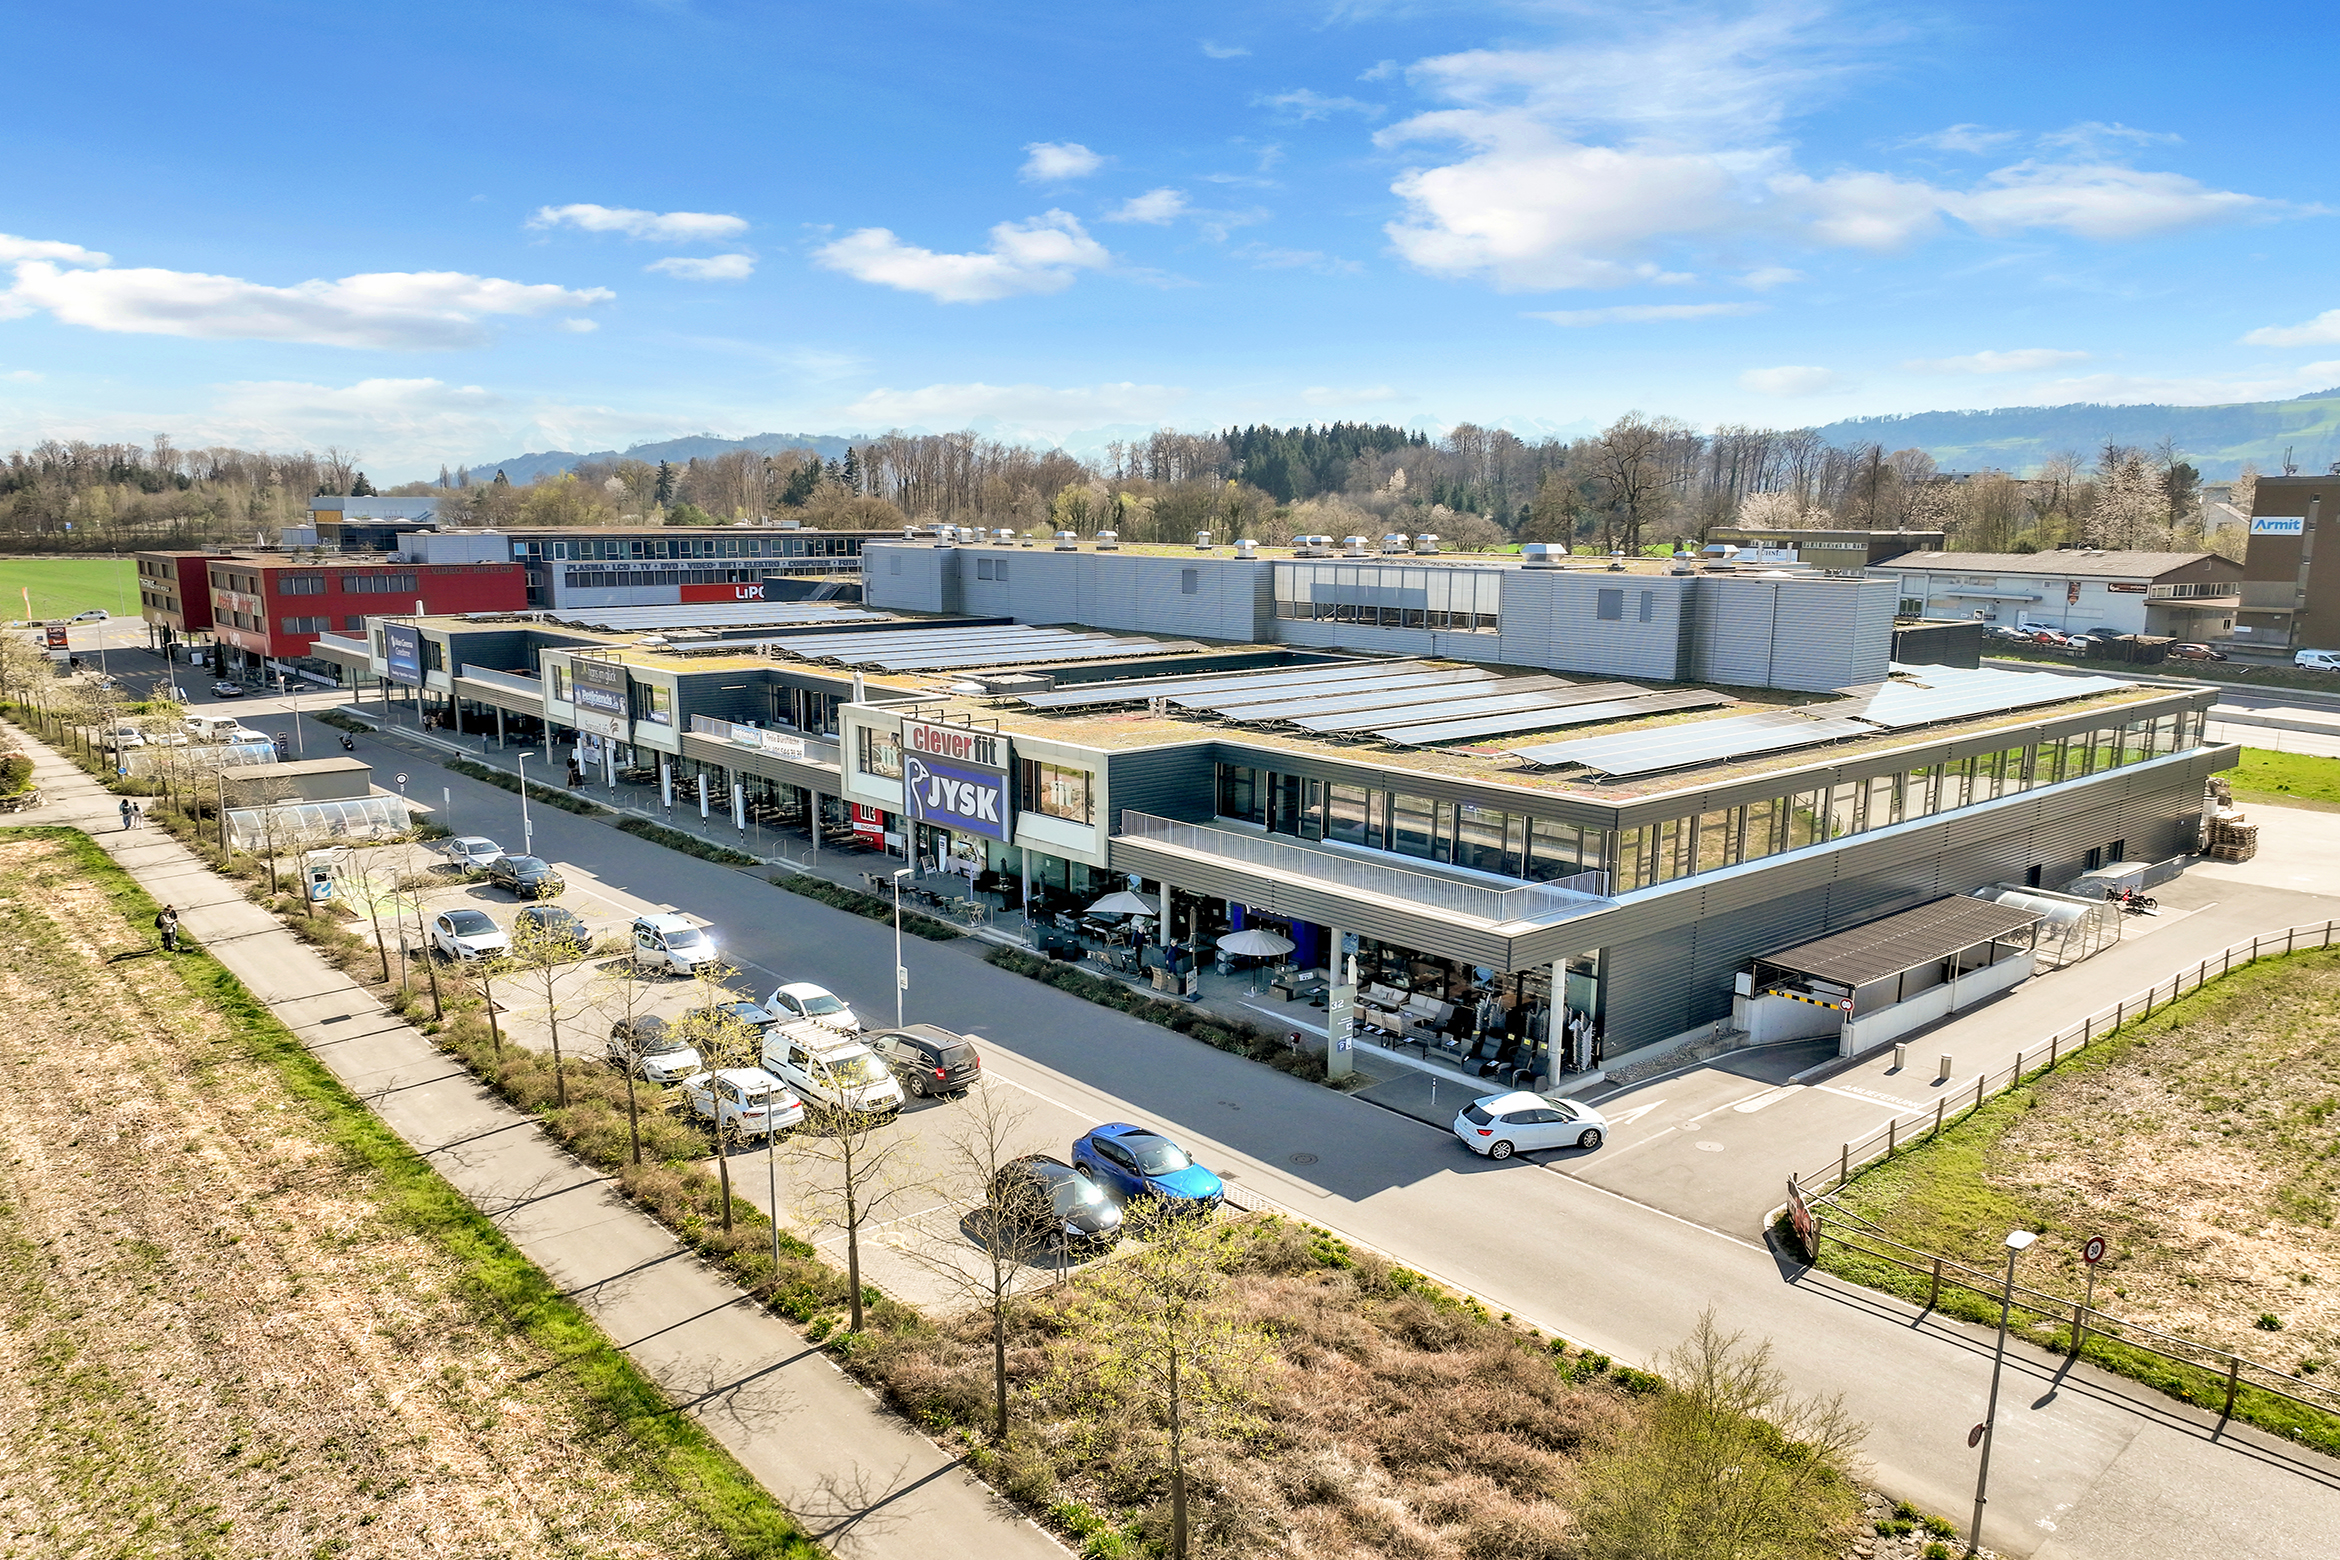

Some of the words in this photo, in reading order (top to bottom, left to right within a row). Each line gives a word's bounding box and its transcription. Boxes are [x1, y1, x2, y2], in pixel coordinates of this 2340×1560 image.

[2254, 519, 2300, 531] Armit
[278, 569, 324, 577] PLASMA
[430, 566, 462, 574] VIDEO
[566, 564, 605, 572] PLASMA
[612, 563, 630, 571] LCD
[661, 562, 678, 570] DVD
[743, 560, 780, 568] ELEKTRO
[913, 725, 971, 759] clever
[973, 735, 997, 765] fit
[927, 775, 999, 823] JYSK
[1331, 1000, 1344, 1010] 32
[1839, 1084, 1922, 1109] ANLIEFERUNG
[2090, 1244, 2100, 1256] 30
